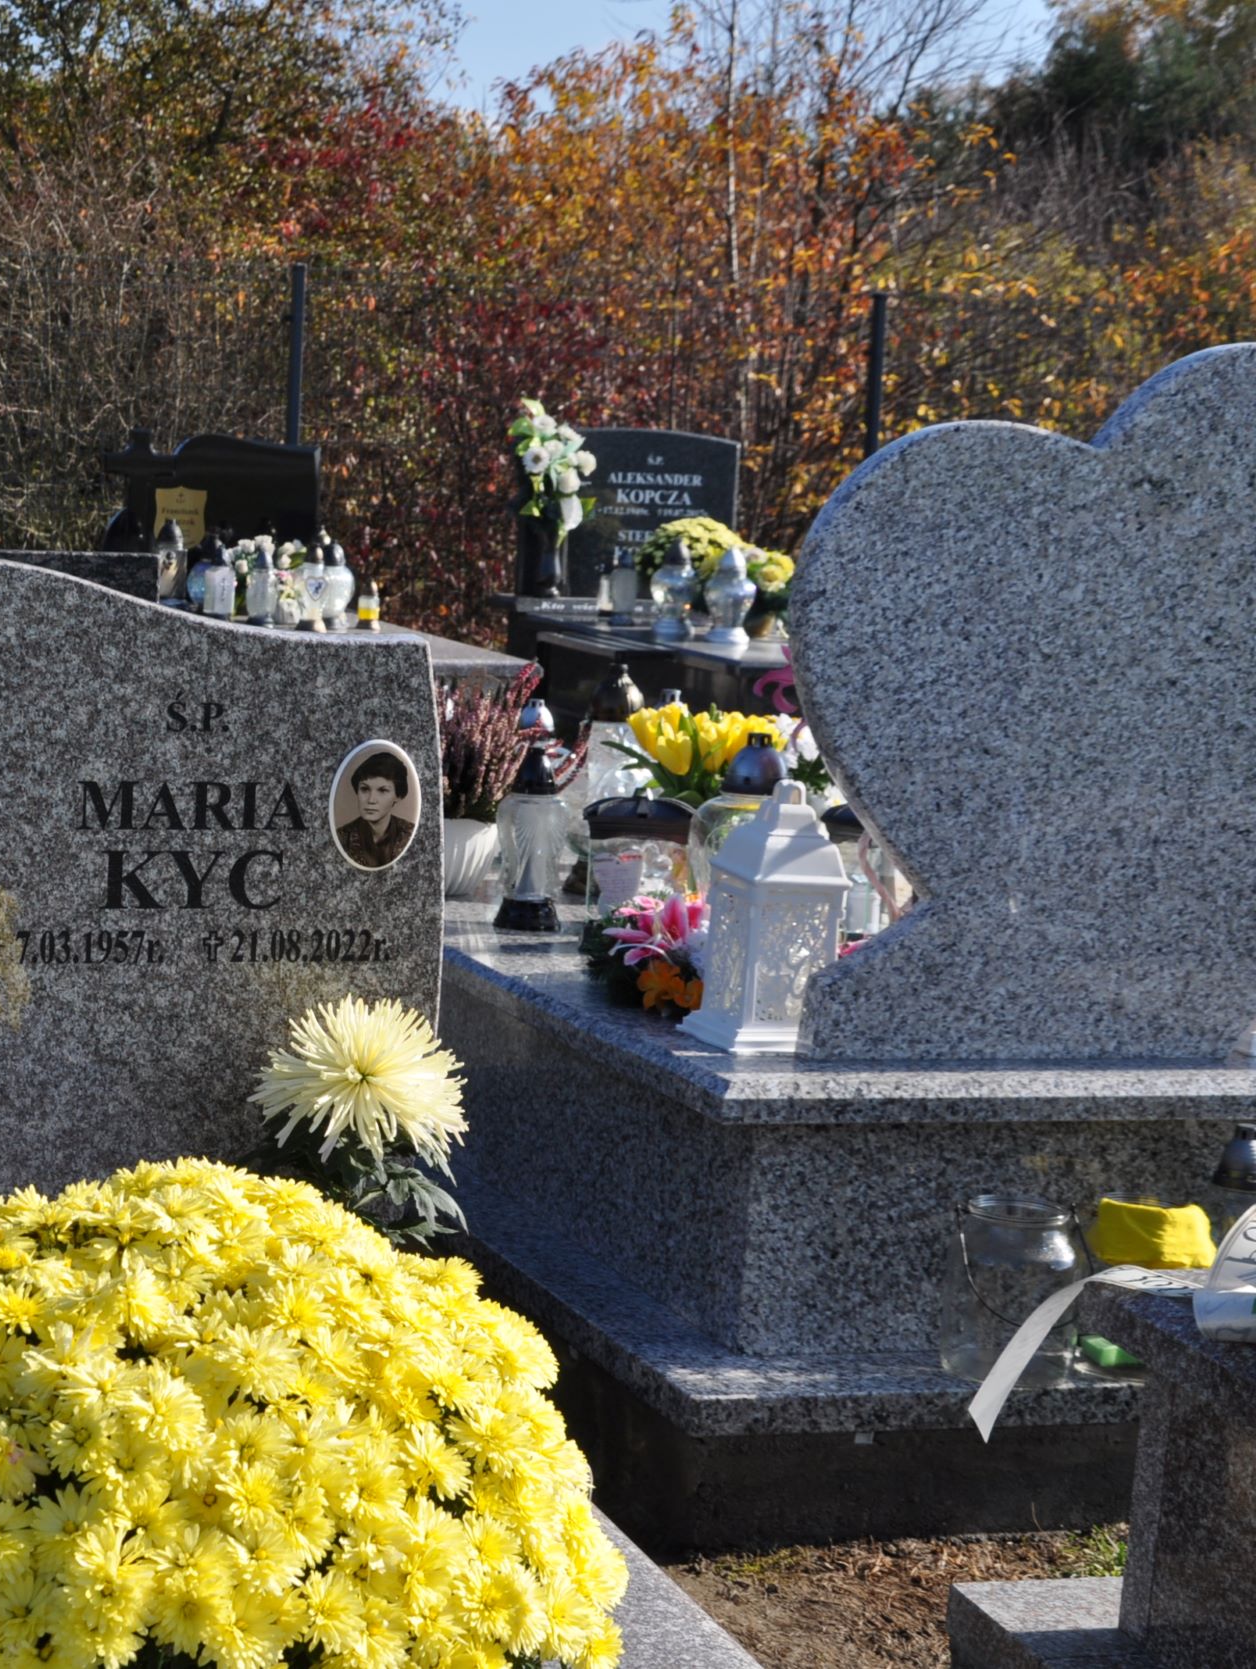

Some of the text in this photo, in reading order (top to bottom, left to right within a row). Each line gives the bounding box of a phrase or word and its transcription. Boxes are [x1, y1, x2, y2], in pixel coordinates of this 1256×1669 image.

[607, 471, 703, 487] ALEKSANDER
[616, 488, 692, 506] KOPCZA
[166, 693, 230, 732] Ś.P.
[77, 780, 308, 831] MARIA
[99, 849, 285, 911] KYC
[16, 928, 391, 964] 7.03.1957r. 21.08.2022r.
